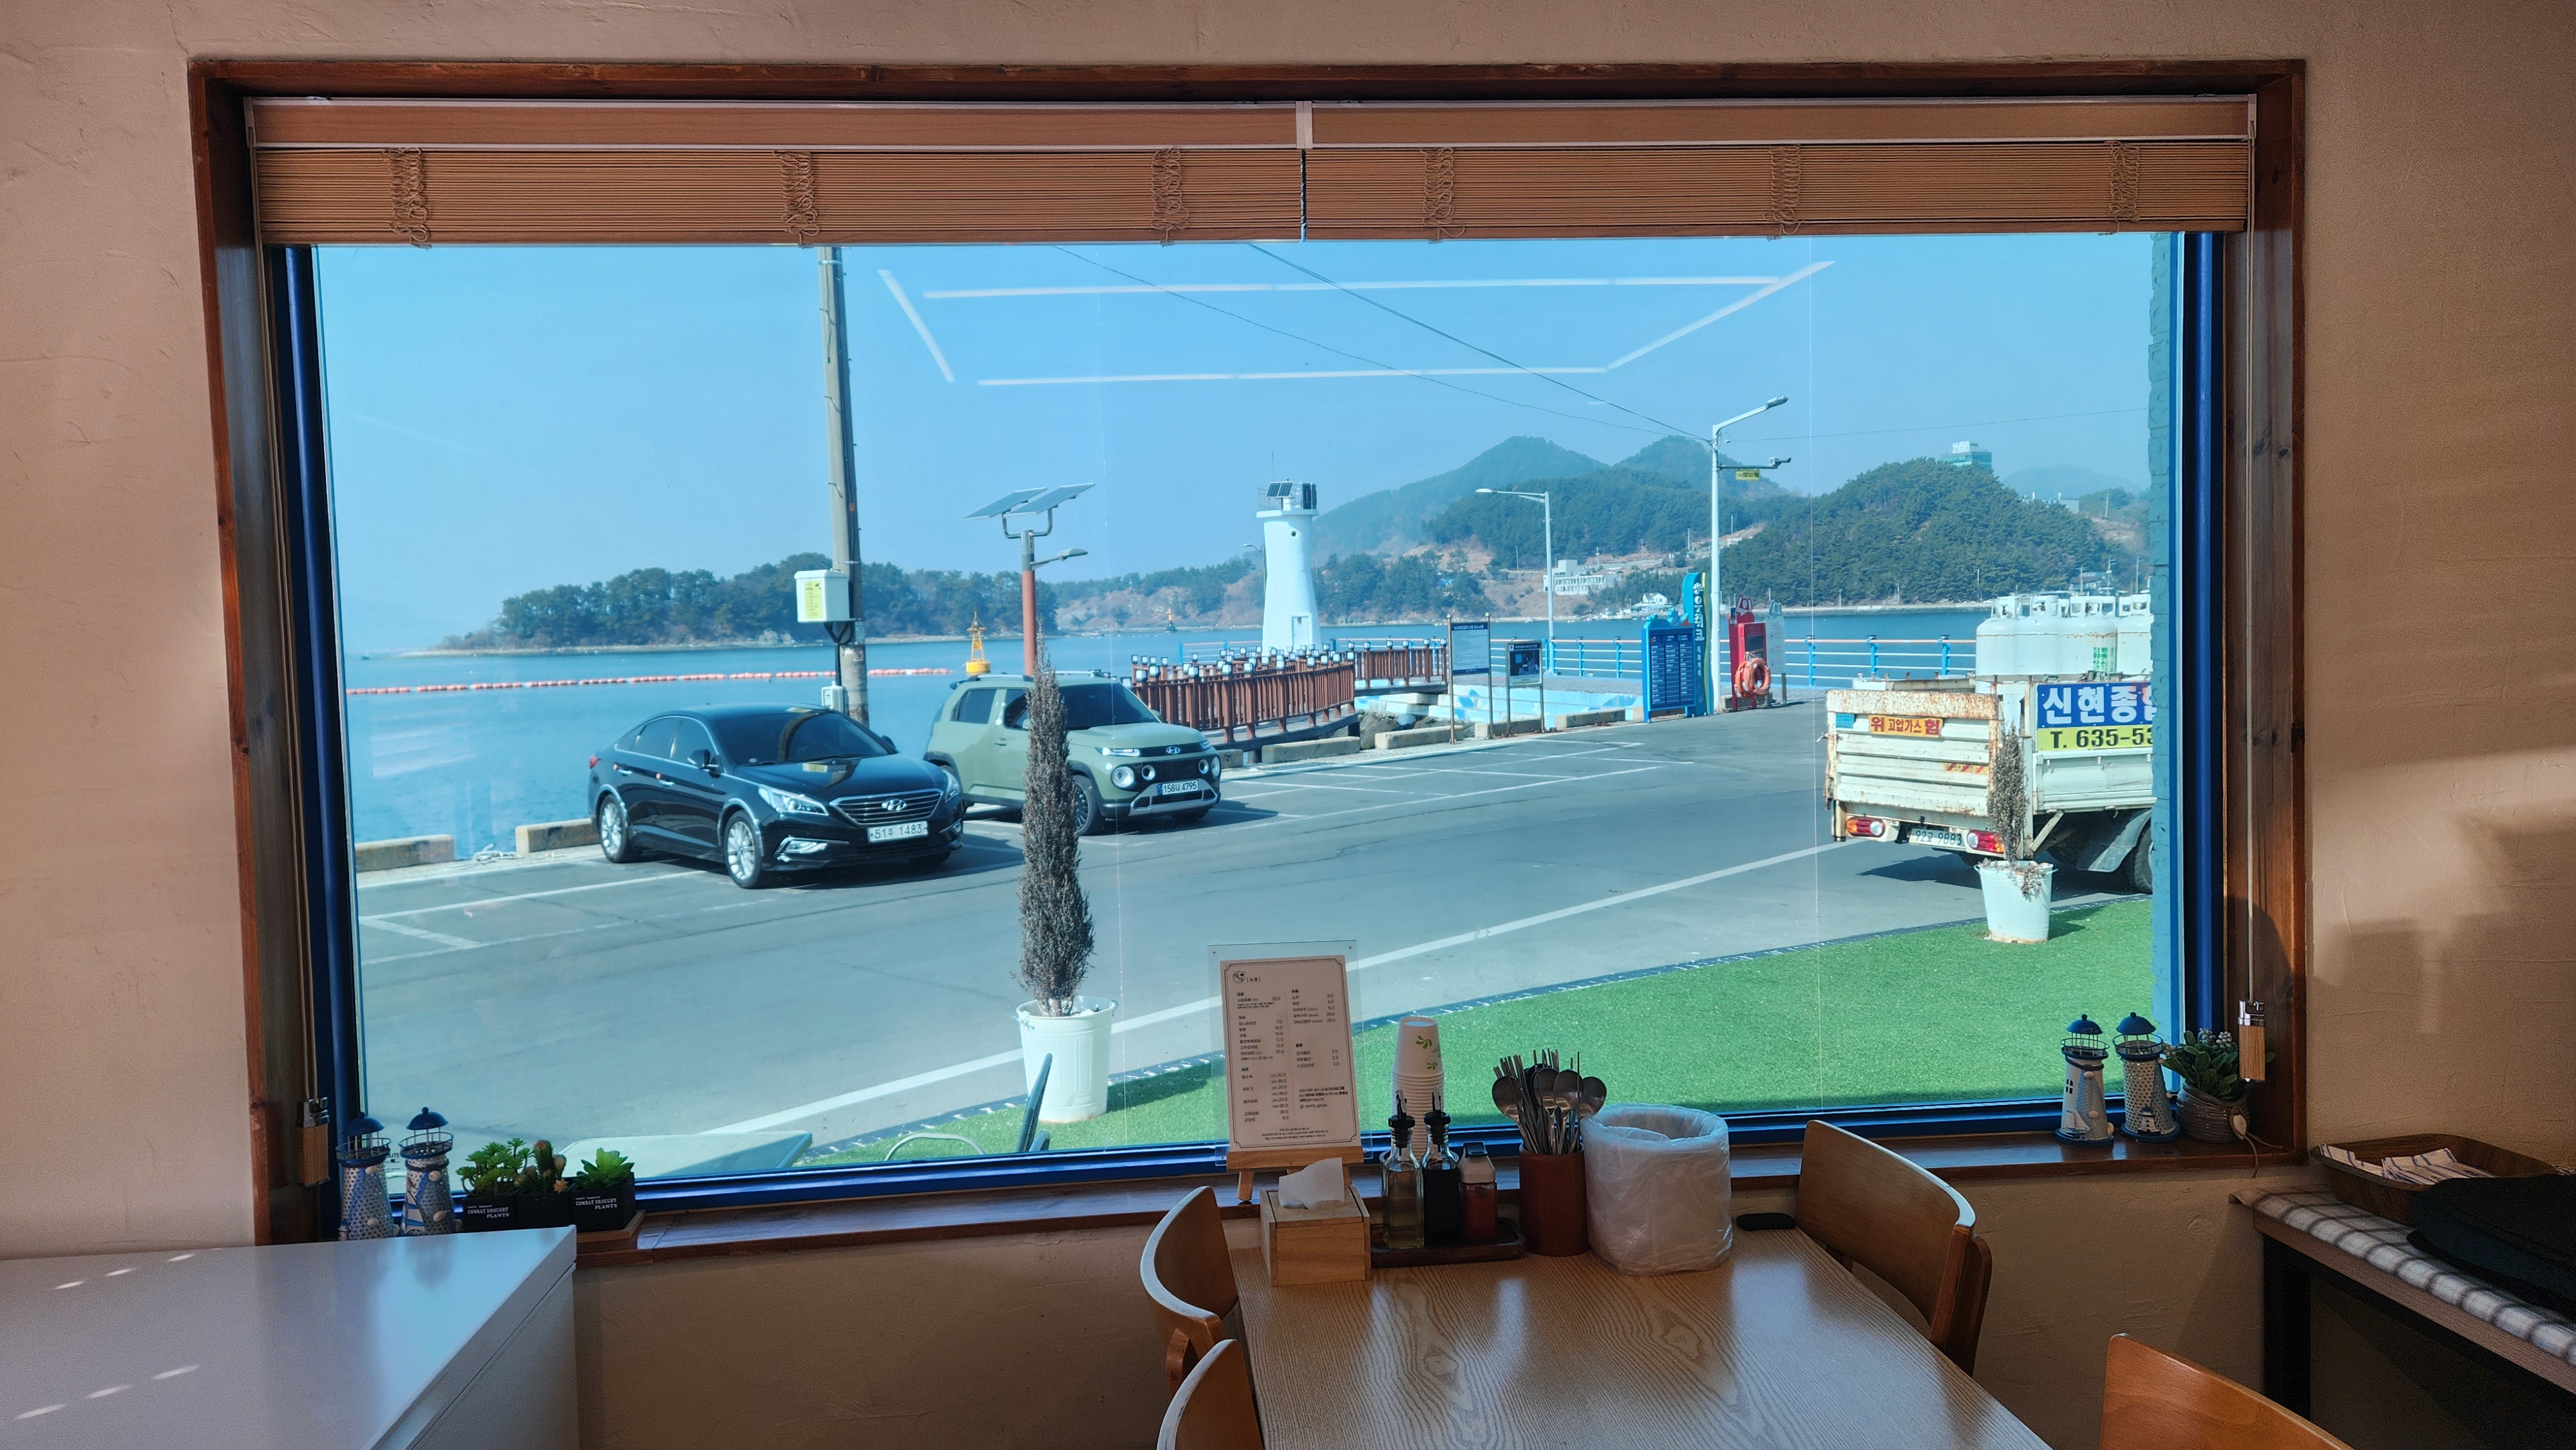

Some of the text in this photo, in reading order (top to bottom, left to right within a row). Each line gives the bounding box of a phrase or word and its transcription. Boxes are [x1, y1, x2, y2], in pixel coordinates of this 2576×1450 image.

[1870, 716, 1885, 732] 위
[1888, 718, 1922, 733] 고압가스
[1924, 719, 1940, 735] 험
[2050, 731, 2067, 749] T.
[1181, 782, 1197, 791] 4795
[875, 824, 922, 839] 51주 1483
[1938, 832, 1962, 845] 9883
